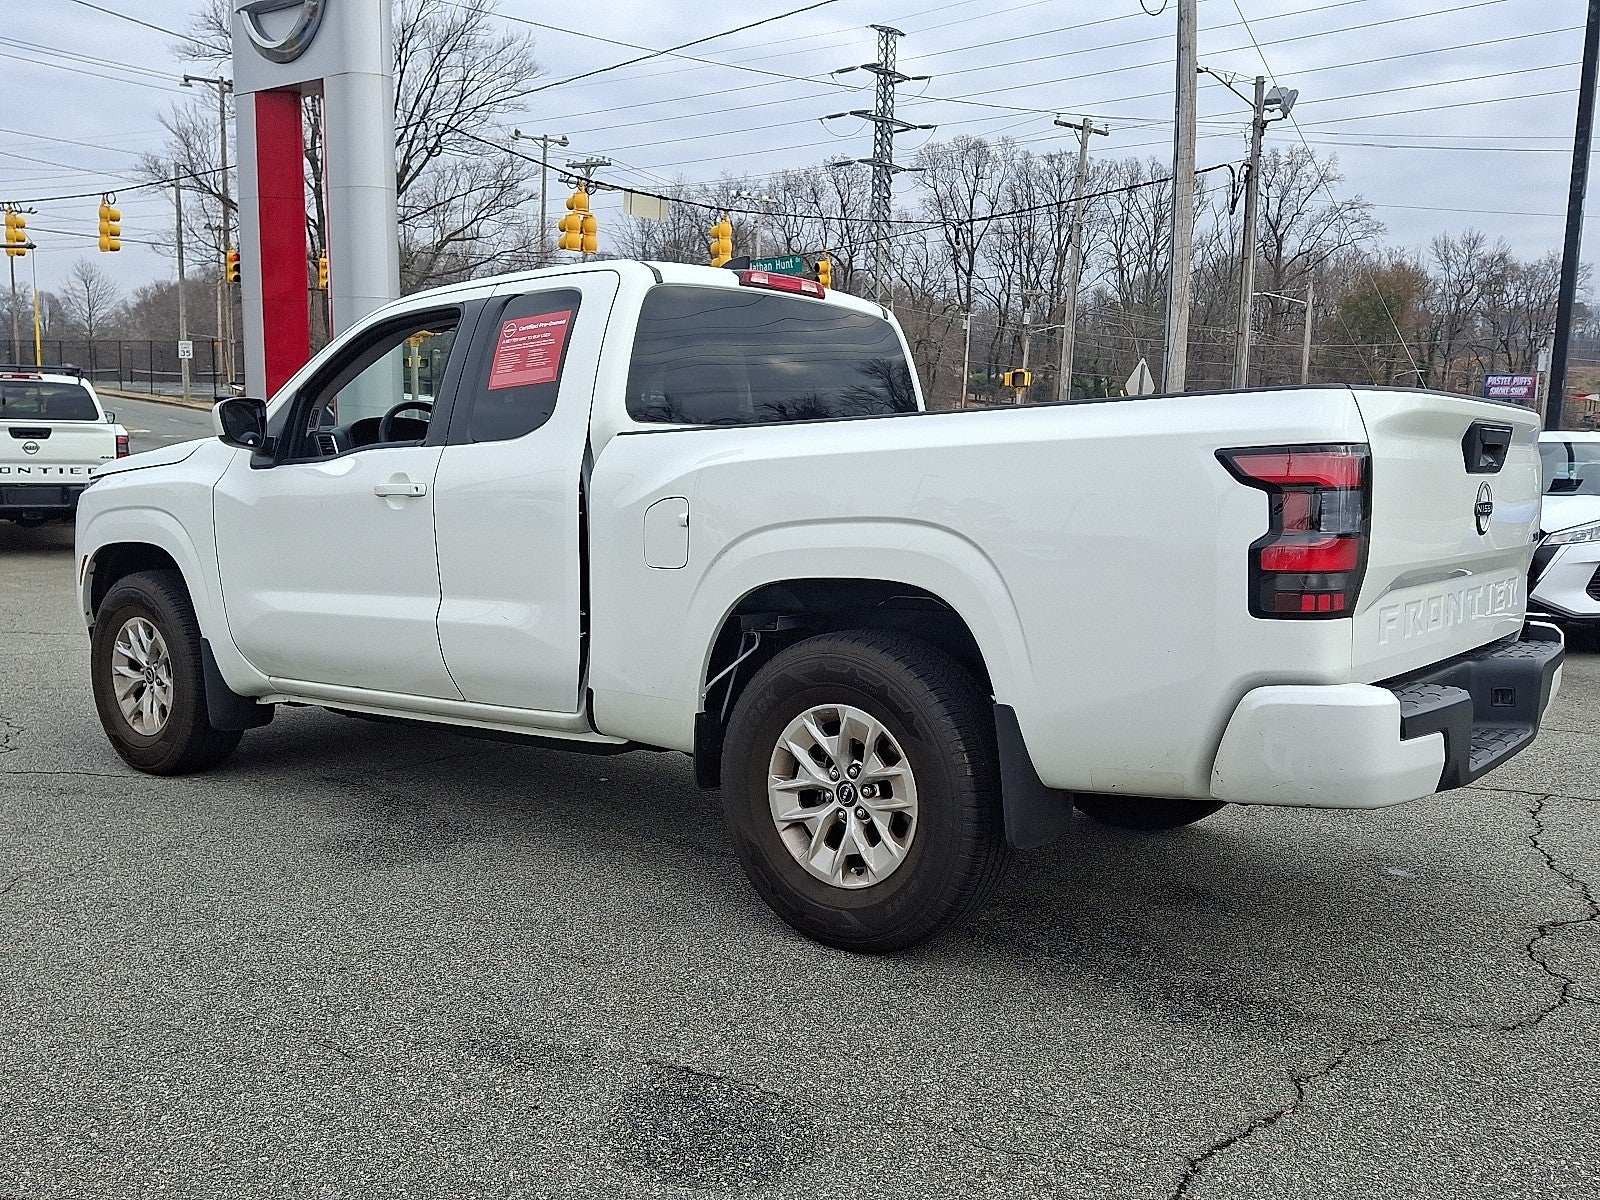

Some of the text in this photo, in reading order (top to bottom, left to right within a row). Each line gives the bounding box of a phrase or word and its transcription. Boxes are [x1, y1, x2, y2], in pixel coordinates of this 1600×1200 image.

[775, 258, 794, 270] Hunt
[539, 319, 567, 328] Pre-Owned
[1510, 387, 1529, 396] SHOP
